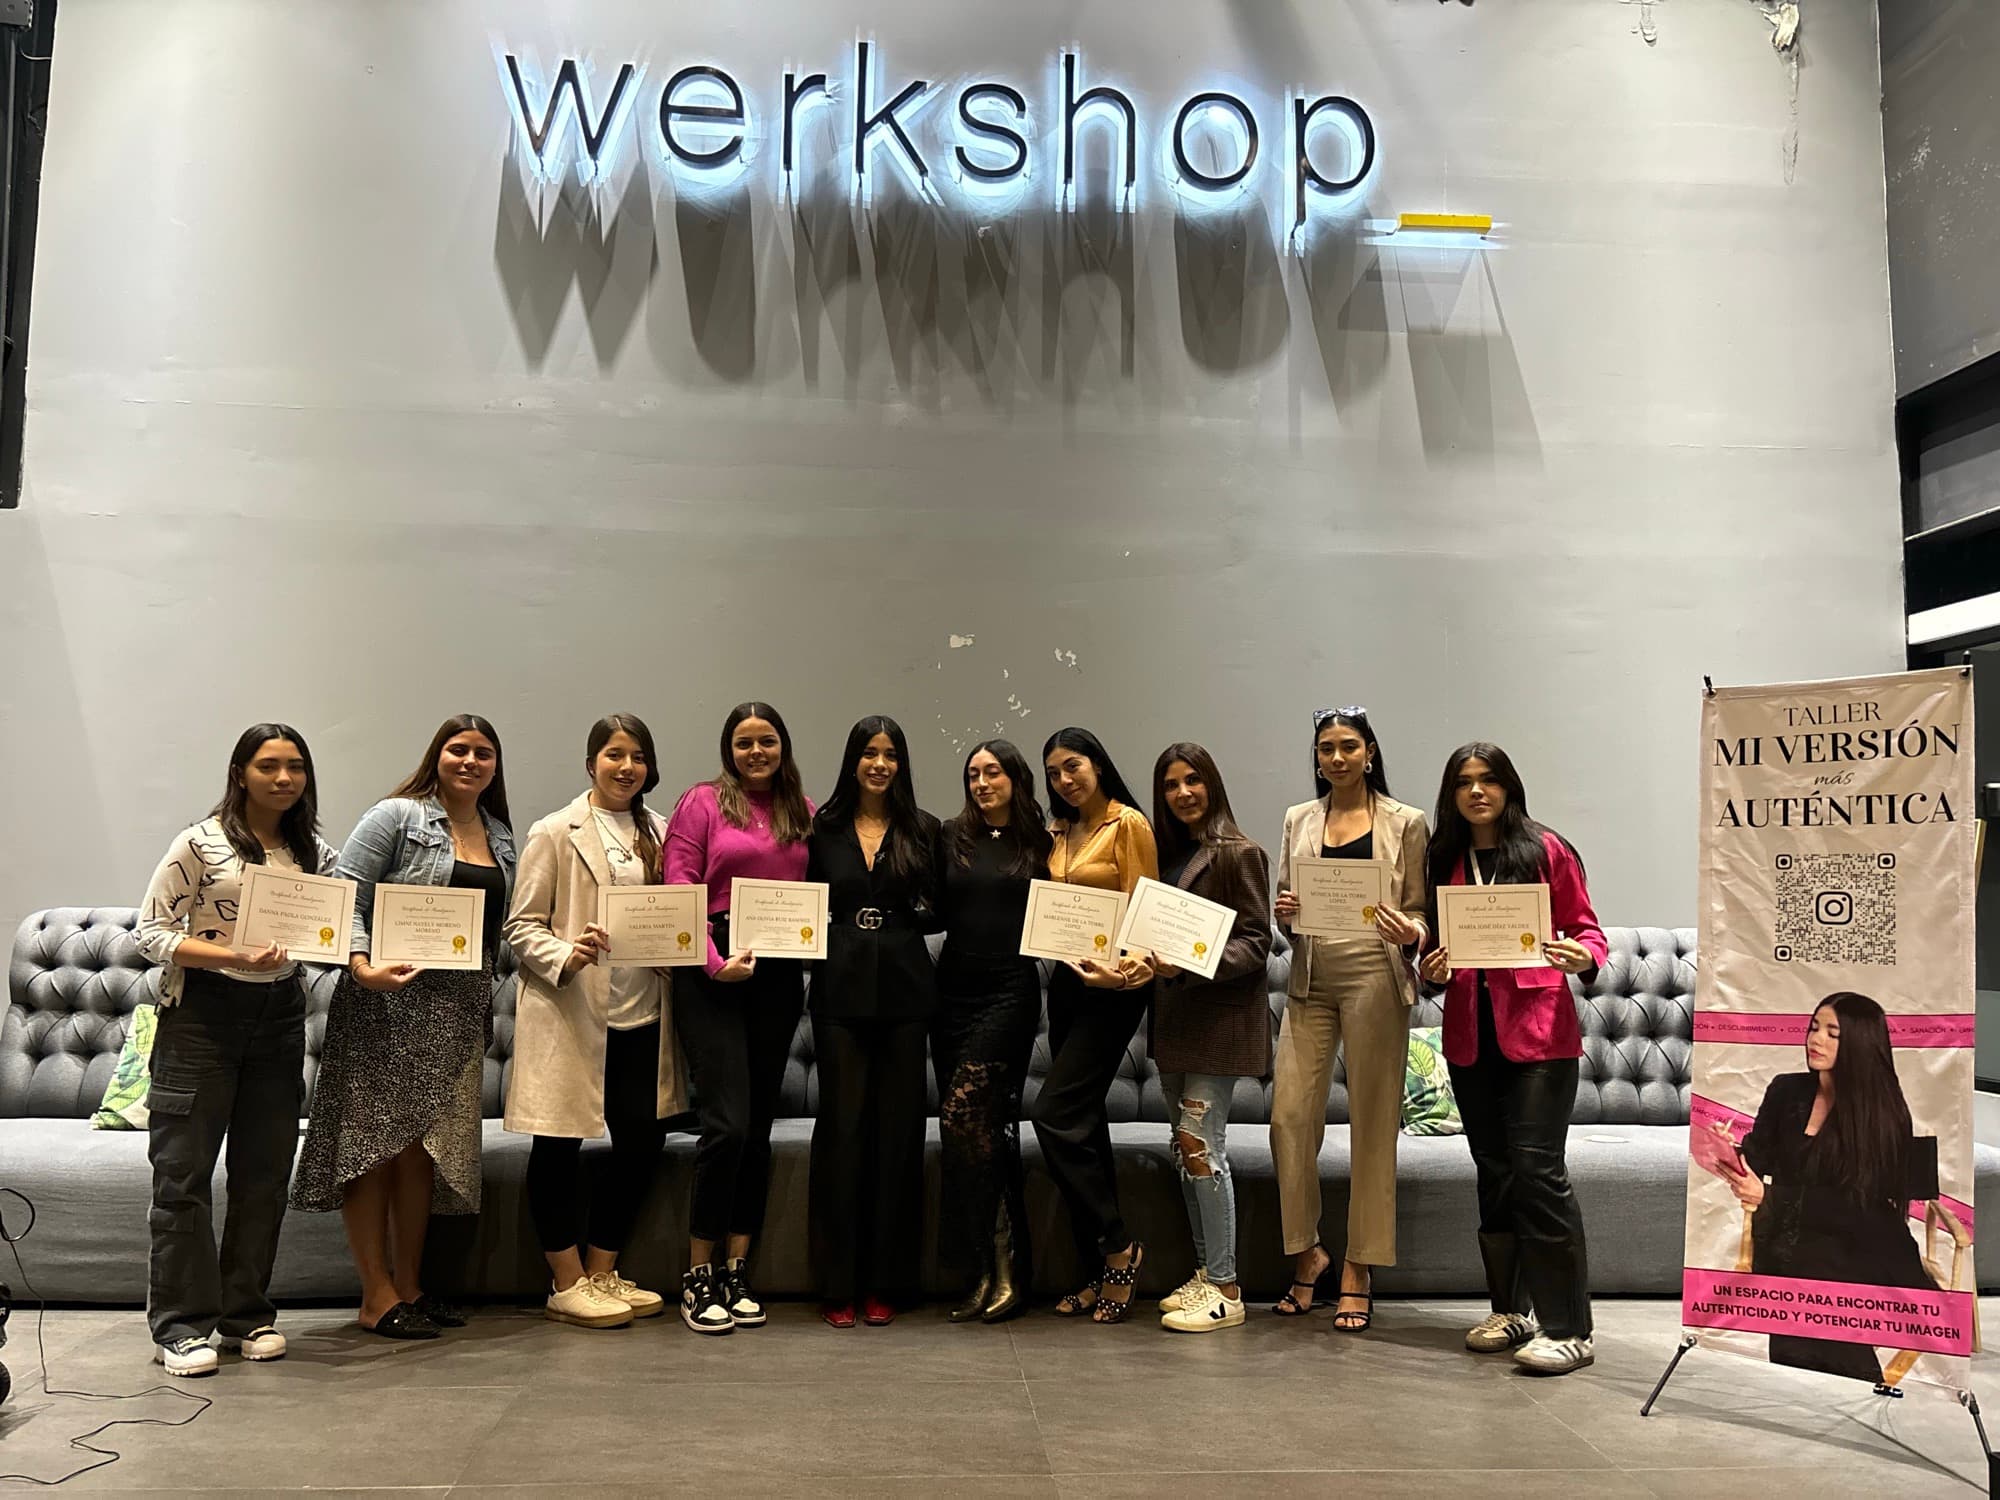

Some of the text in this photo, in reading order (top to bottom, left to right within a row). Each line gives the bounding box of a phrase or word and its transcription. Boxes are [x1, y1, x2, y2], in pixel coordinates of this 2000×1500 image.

[1783, 701, 1882, 727] TALLER
[1714, 719, 1961, 767] MI VERSIÓN
[1814, 770, 1855, 786] más
[1715, 790, 1957, 828] AUTÉNTICA
[1713, 1285, 1940, 1316] UN ESPACIO PARA ENCONTRAR TU
[1692, 1302, 1960, 1340] AUTENTICIDAD Y POTENCIAR TU IMAGEN
